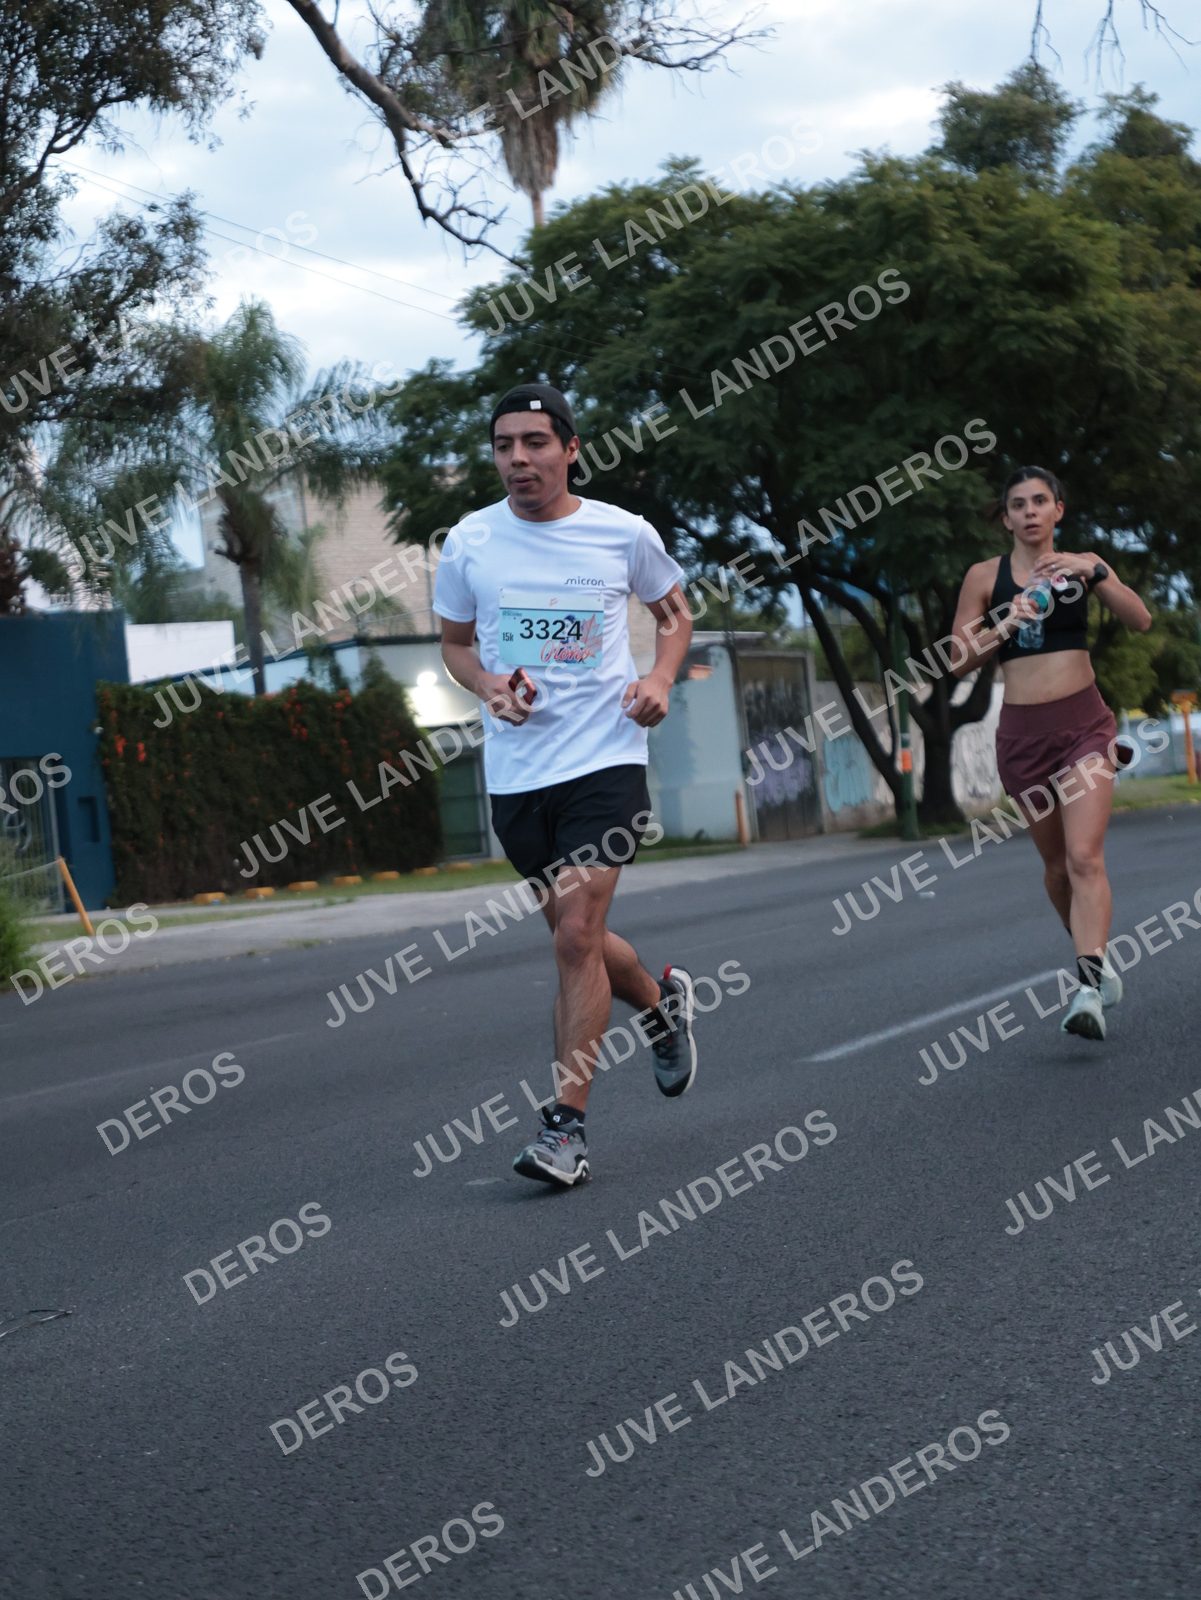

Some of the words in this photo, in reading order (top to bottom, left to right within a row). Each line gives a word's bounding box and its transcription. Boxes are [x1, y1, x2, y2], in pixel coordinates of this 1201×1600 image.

[564, 576, 606, 587] micron
[520, 618, 583, 641] 3324
[502, 632, 514, 642] 15k
